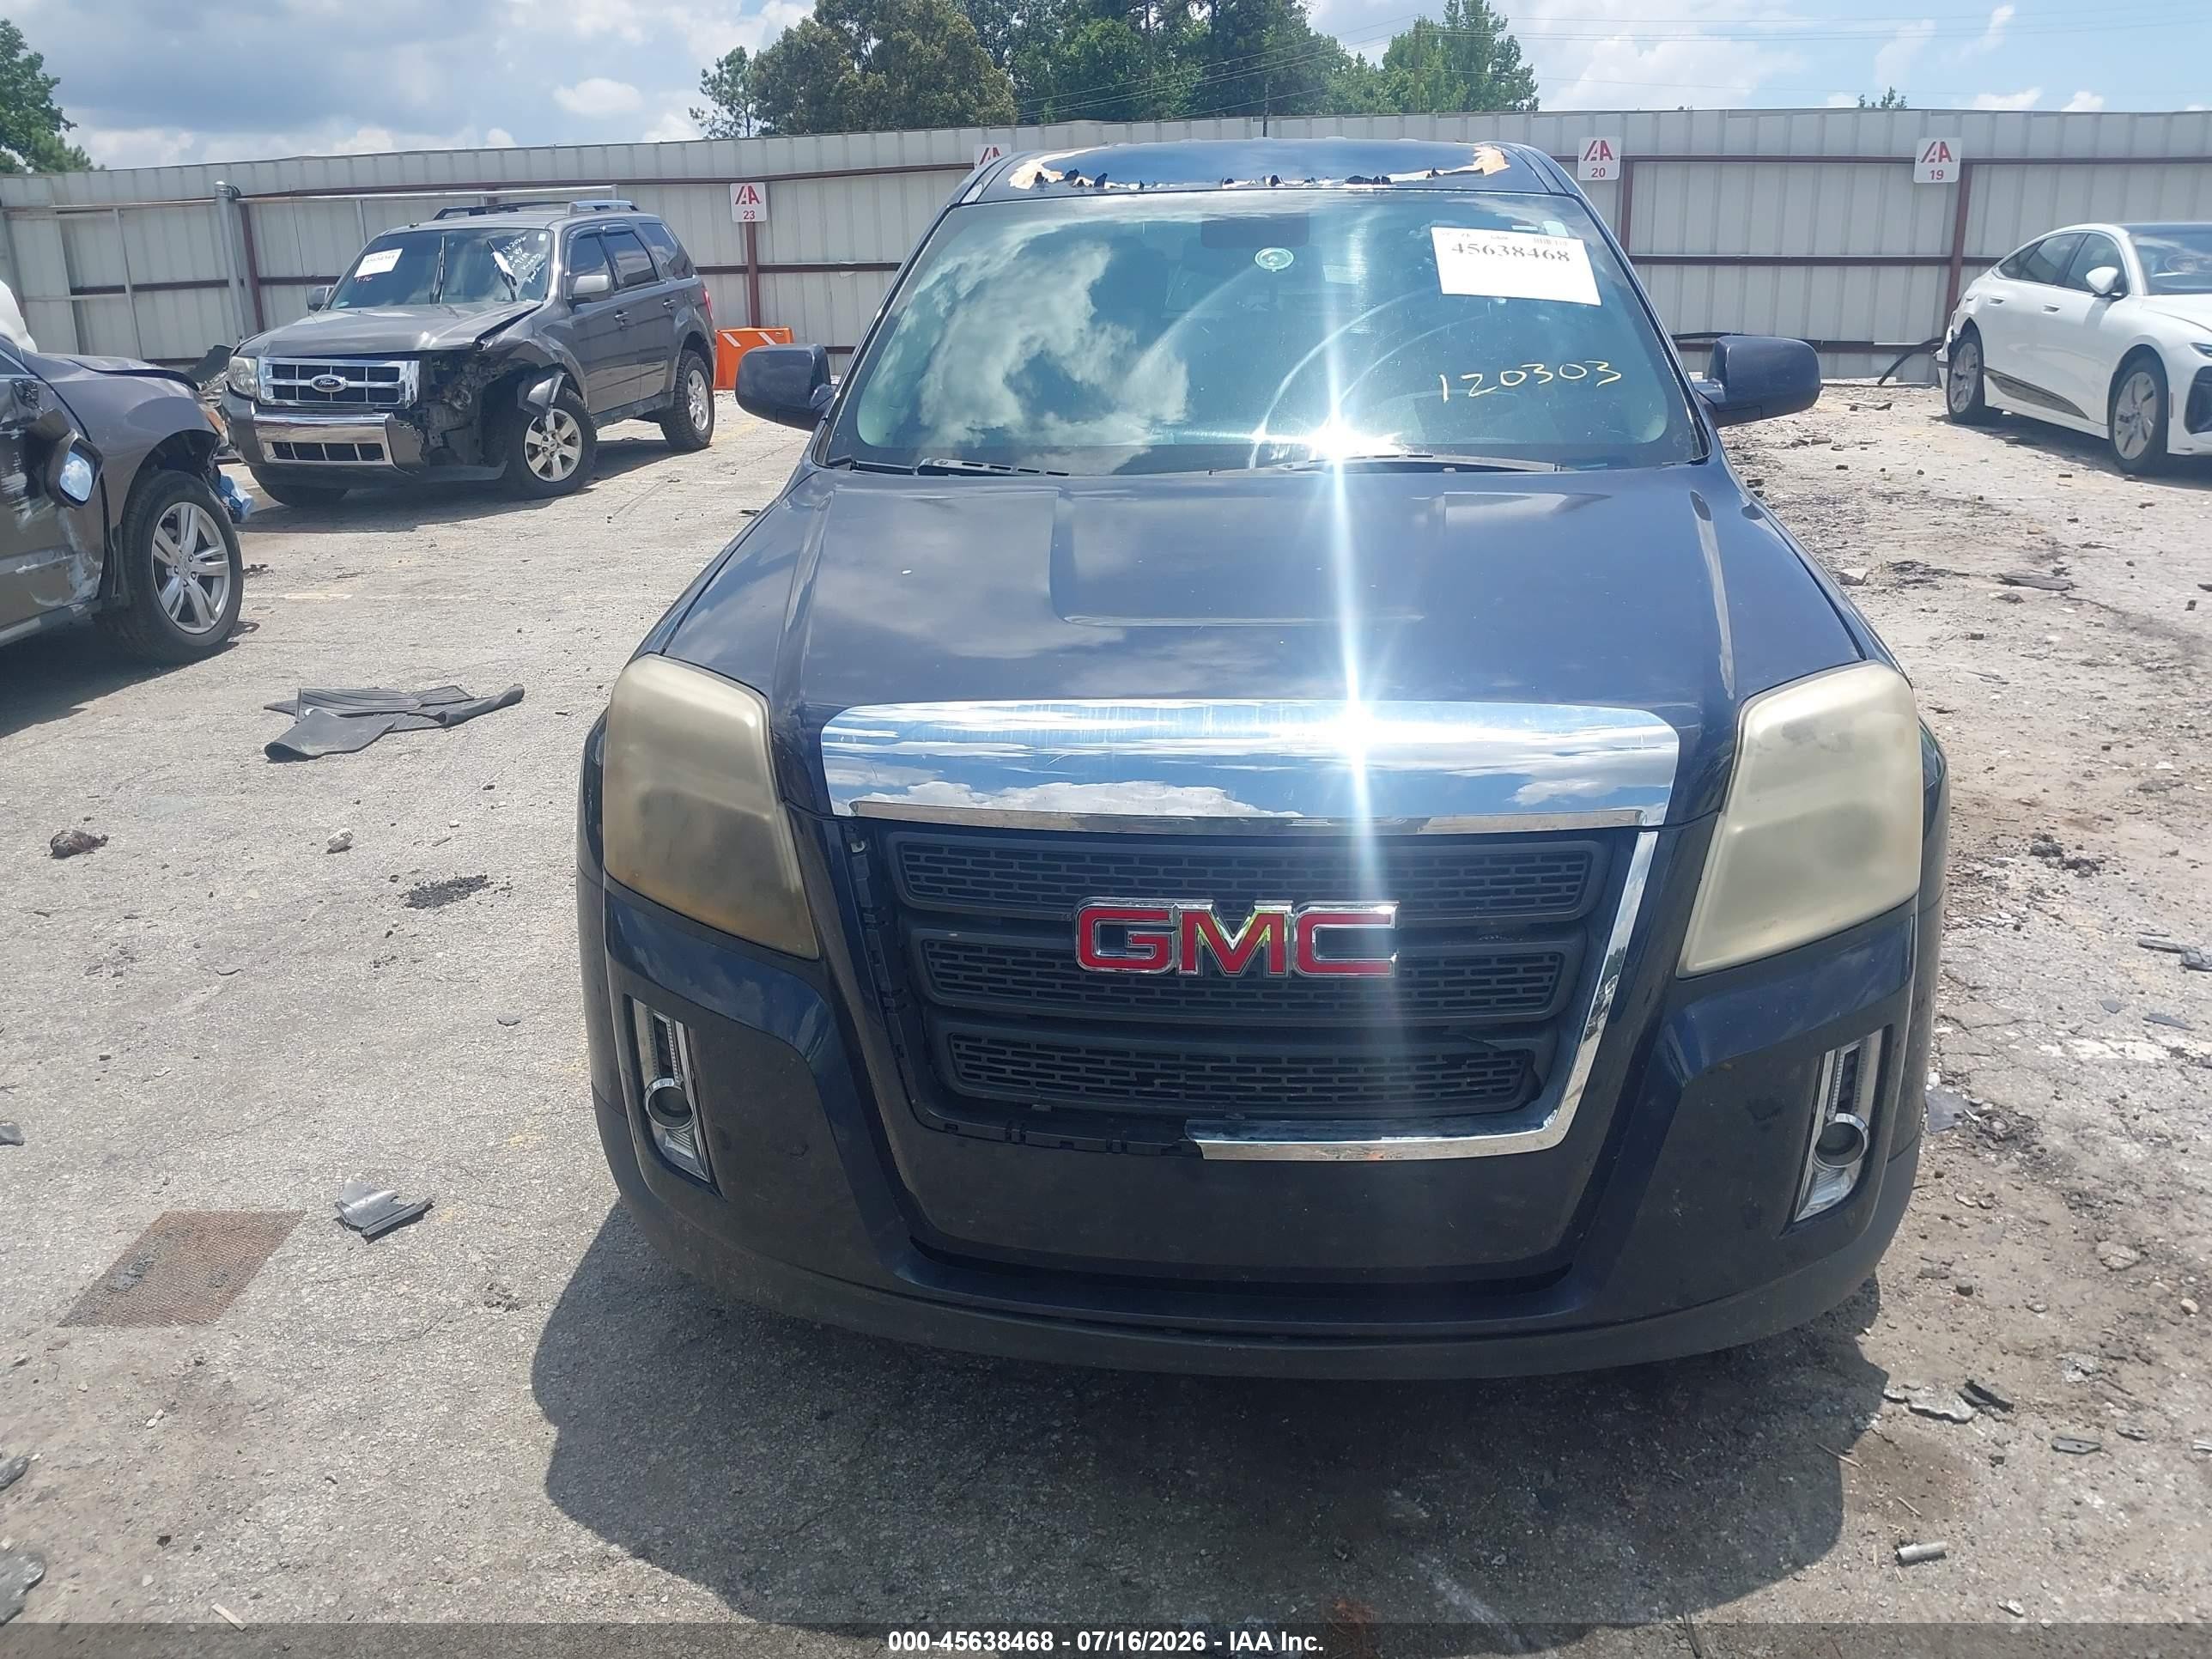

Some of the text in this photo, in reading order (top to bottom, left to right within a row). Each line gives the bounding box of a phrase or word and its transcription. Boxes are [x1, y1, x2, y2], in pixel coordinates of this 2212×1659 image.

[1591, 167, 1606, 178] 20
[1930, 169, 1944, 180] 19
[743, 210, 756, 220] 23
[1451, 242, 1571, 262] 45638468
[1439, 360, 1622, 403] 120303
[1074, 896, 1400, 977] GMC
